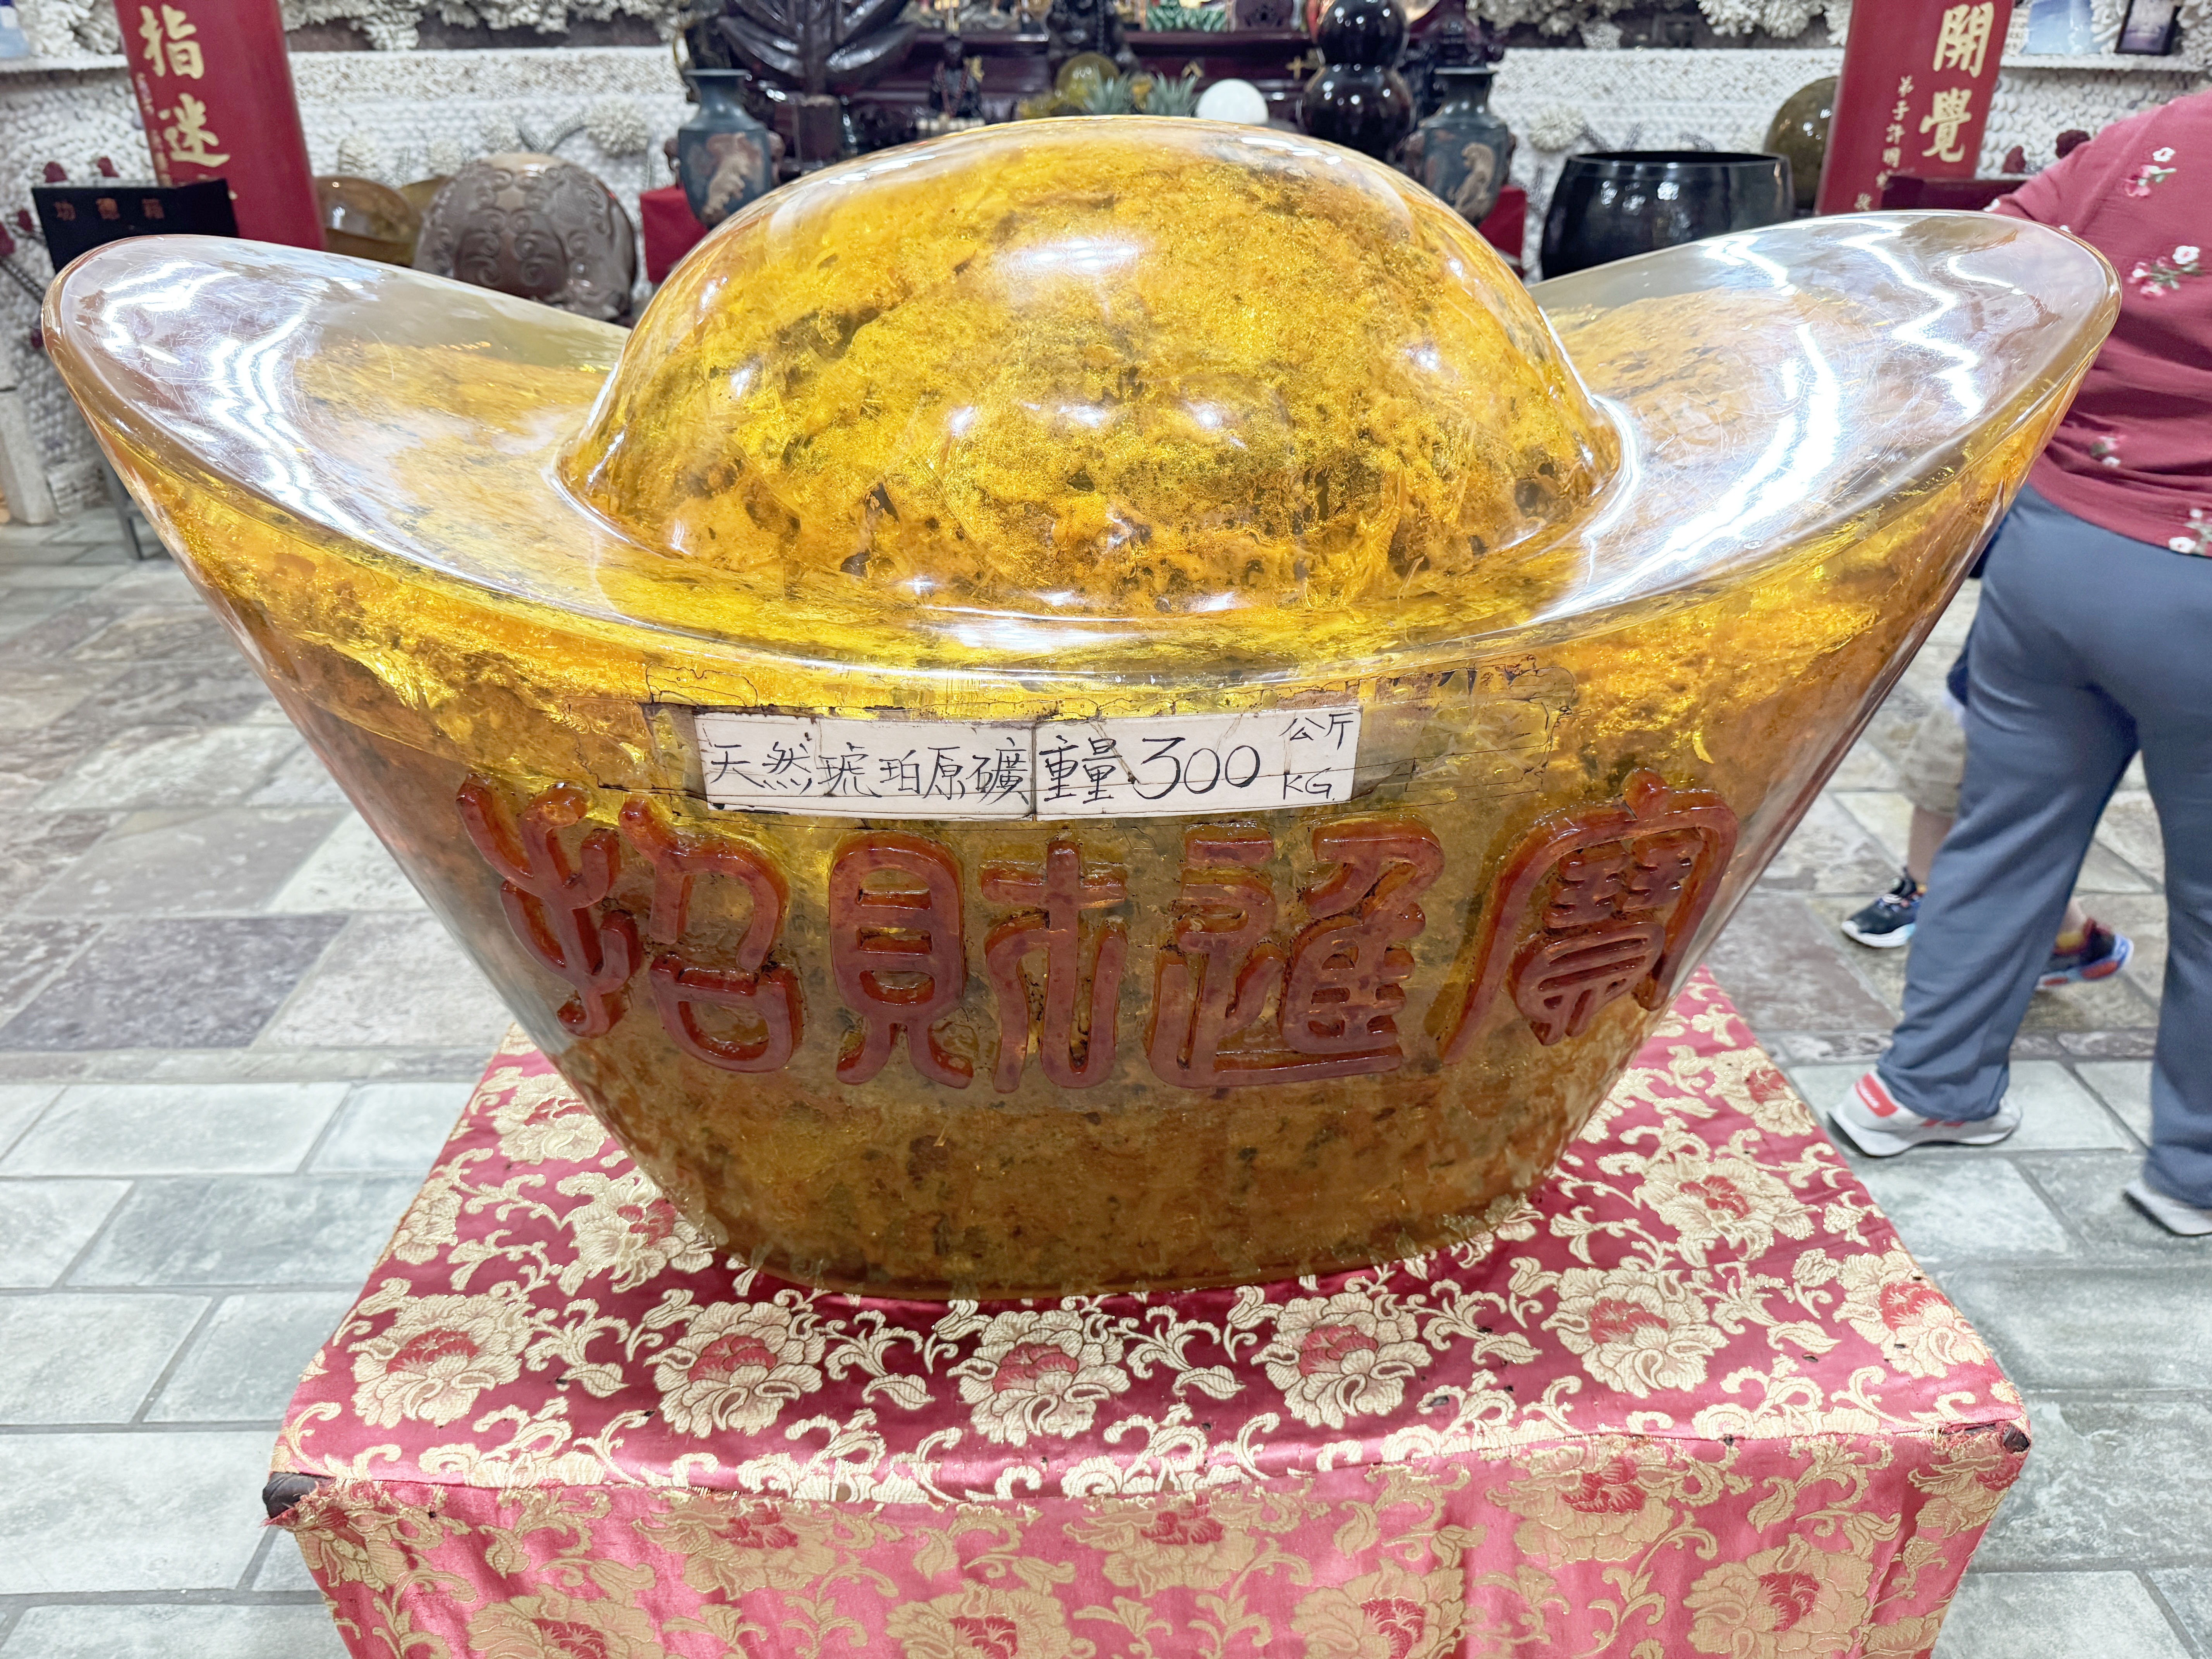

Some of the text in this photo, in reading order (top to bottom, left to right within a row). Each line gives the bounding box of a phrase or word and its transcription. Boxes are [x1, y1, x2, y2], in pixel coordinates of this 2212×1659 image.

[139, 4, 238, 200] 指迷
[1919, 2, 1994, 163] 開覺
[1279, 713, 1354, 750] 公斤
